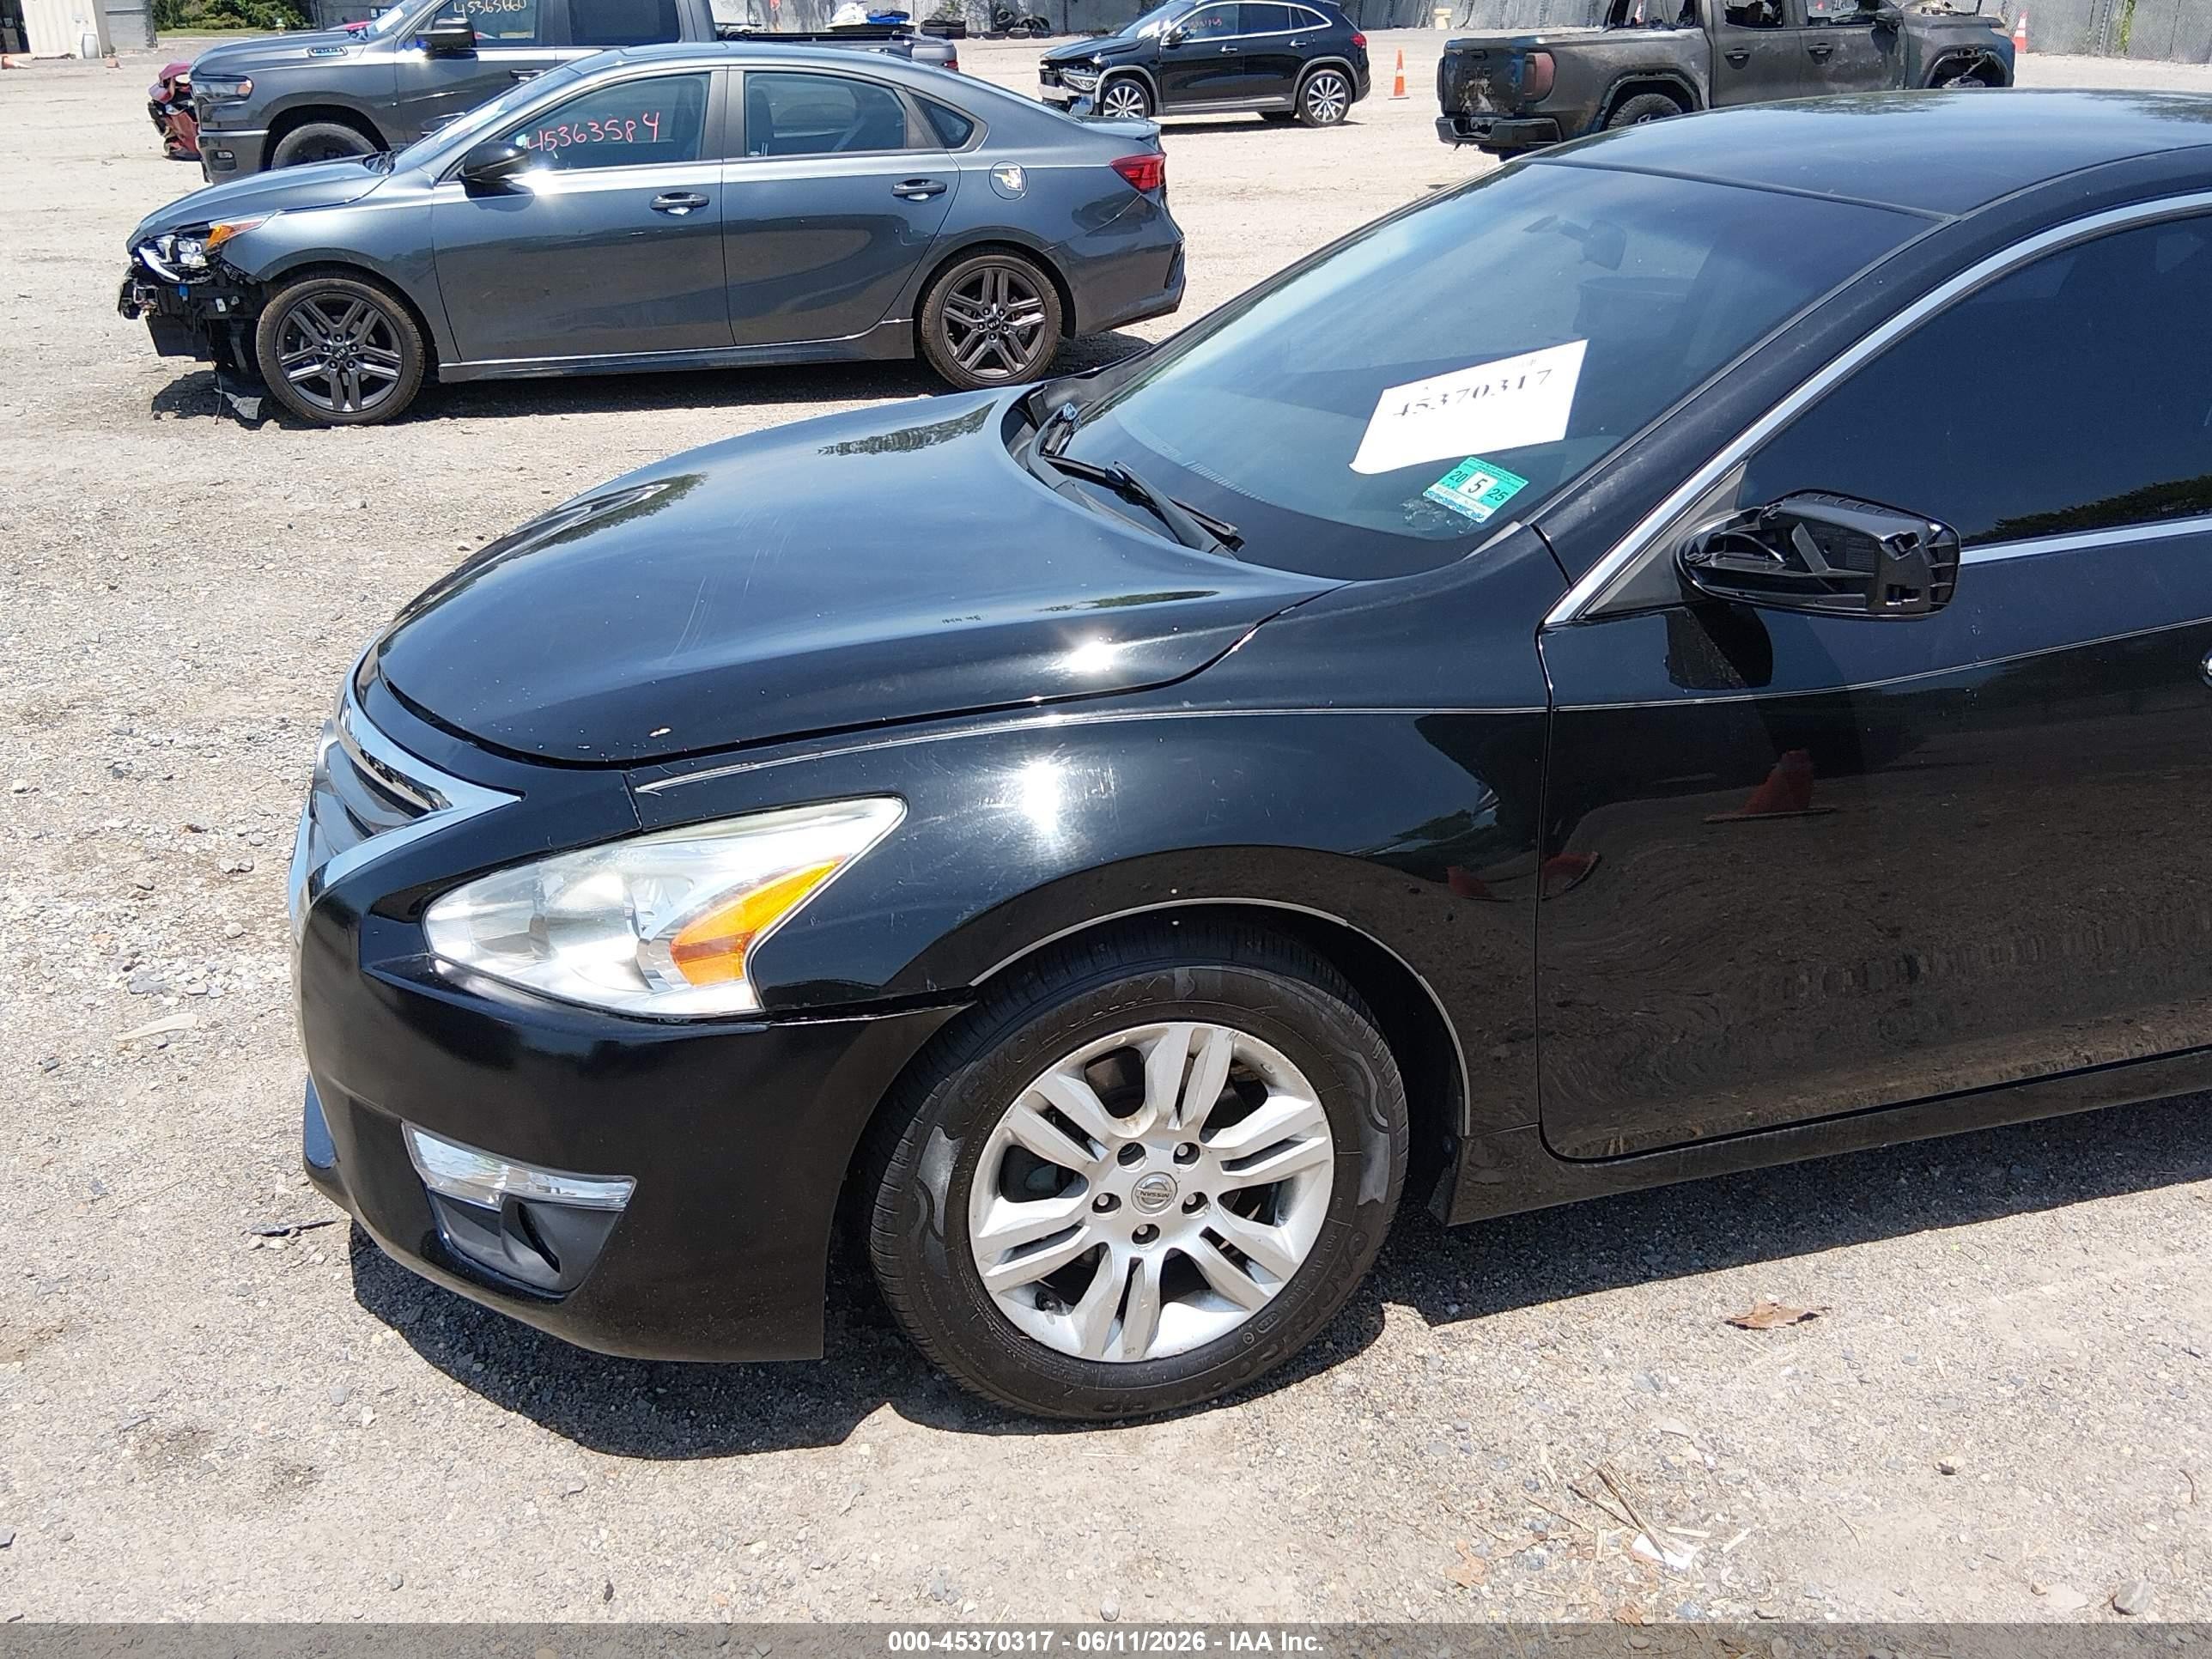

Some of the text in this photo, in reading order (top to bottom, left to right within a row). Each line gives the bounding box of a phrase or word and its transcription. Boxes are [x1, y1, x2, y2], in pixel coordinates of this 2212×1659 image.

[526, 112, 660, 152] 45363584
[1449, 470, 1468, 483] 20
[1468, 477, 1488, 494] 5
[1487, 488, 1509, 501] 25
